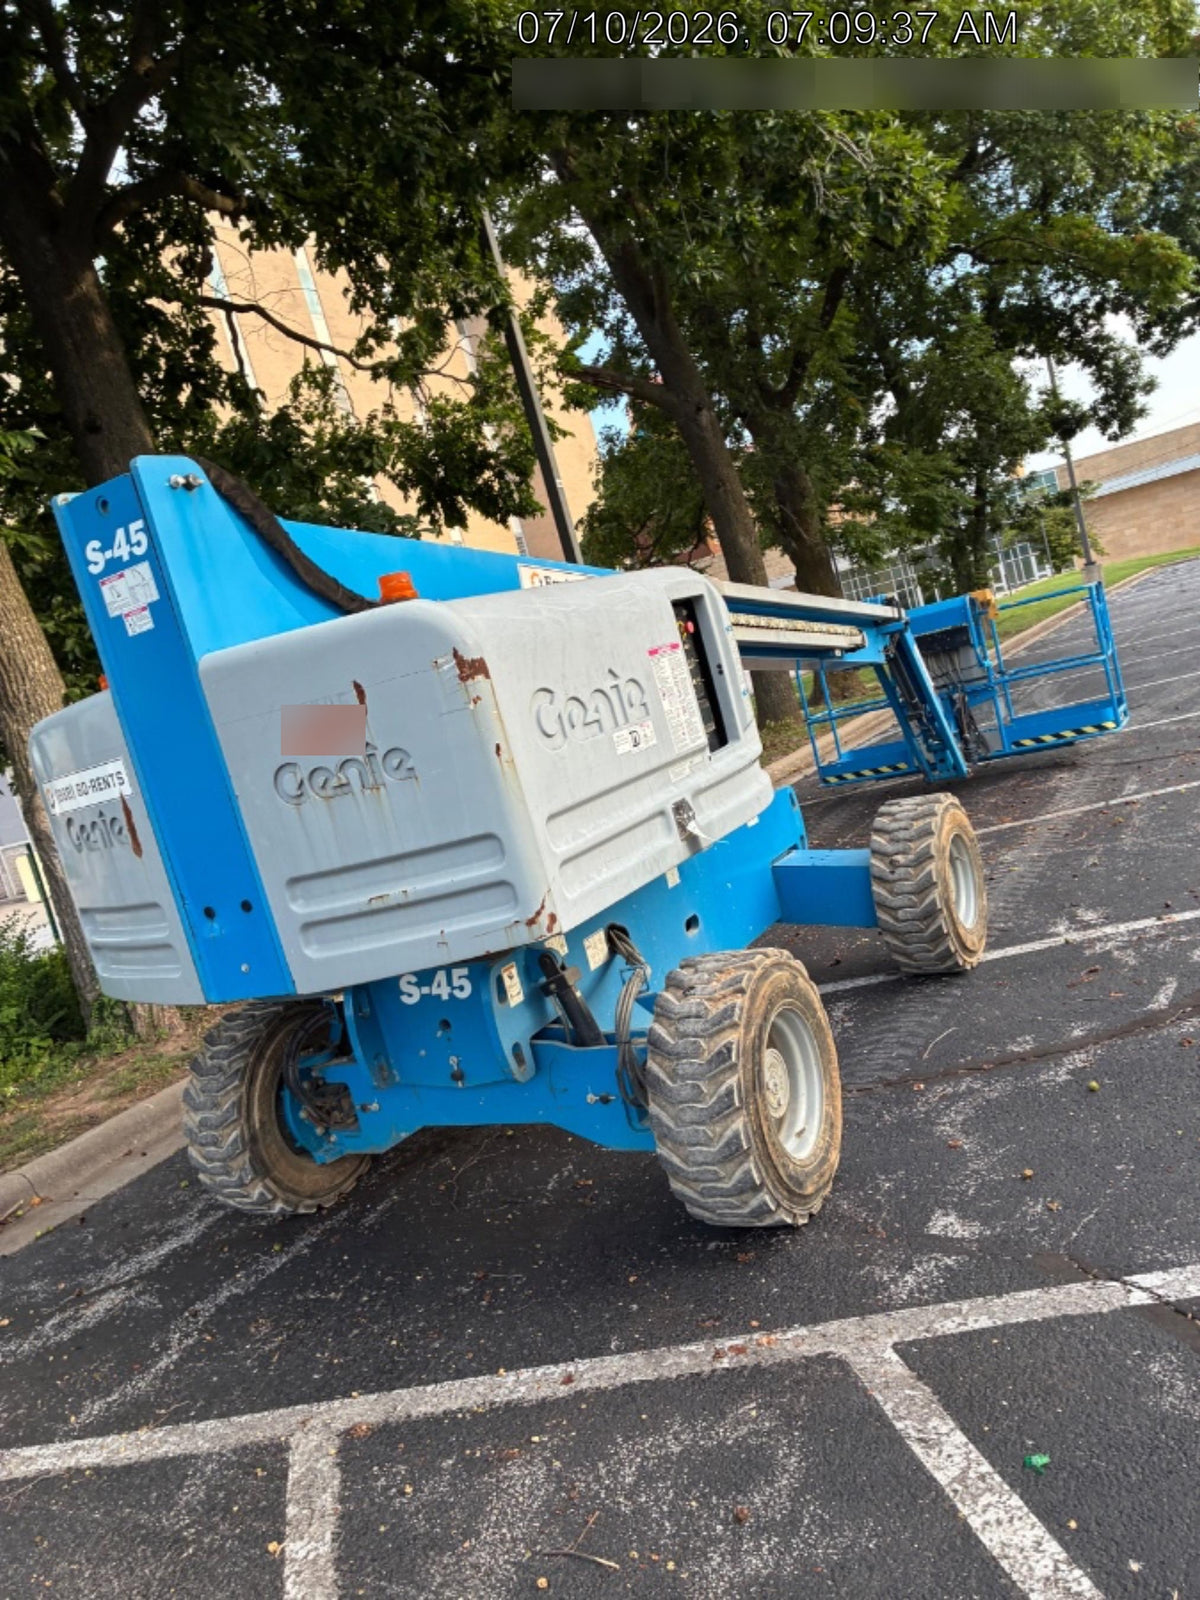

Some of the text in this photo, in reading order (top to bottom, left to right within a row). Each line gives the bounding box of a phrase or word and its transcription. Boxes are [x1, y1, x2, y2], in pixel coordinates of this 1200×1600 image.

[85, 519, 148, 575] S-45
[531, 668, 650, 750] Genie
[273, 741, 415, 806] Genie
[66, 809, 129, 853] Genie
[399, 967, 472, 1005] S-45
